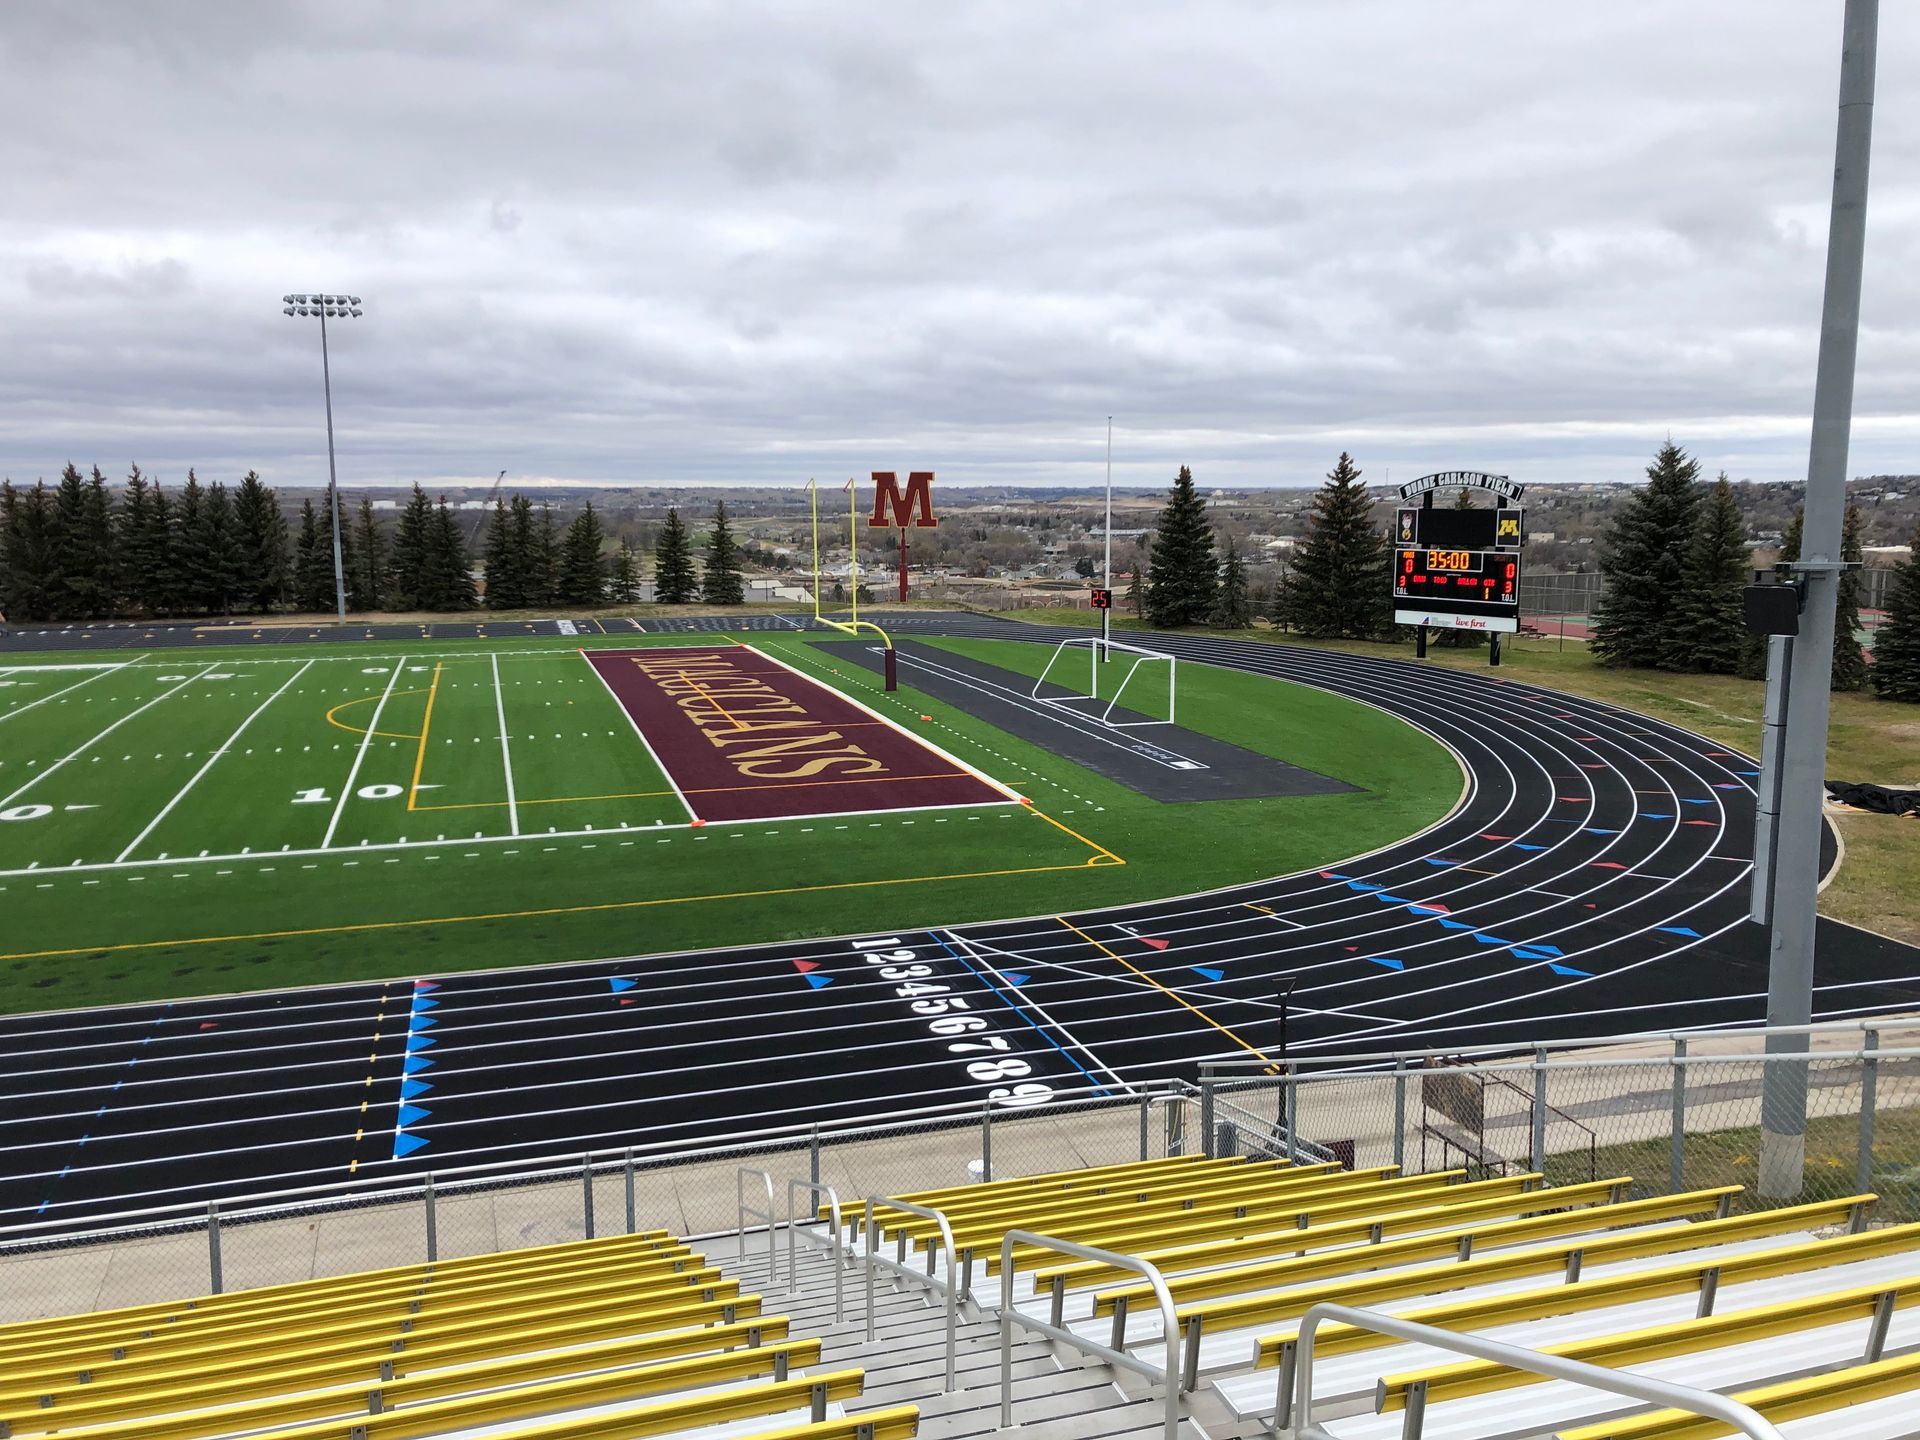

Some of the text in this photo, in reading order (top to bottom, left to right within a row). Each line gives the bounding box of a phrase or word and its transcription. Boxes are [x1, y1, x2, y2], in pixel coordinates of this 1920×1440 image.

[1404, 472, 1516, 497] DUANE CARLSON FIELD
[868, 471, 938, 528] M
[1498, 519, 1519, 536] M
[1405, 559, 1413, 573] 0
[1429, 551, 1469, 569] 35:00
[1506, 563, 1515, 578] 0
[1399, 576, 1406, 586] 3
[1505, 581, 1512, 593] 3
[1092, 591, 1107, 607] 25
[1485, 588, 1489, 600] 1
[1456, 616, 1469, 626] live
[1470, 619, 1487, 628] first
[631, 655, 890, 778] MAGICIANS
[851, 937, 902, 949] 1
[863, 949, 916, 964] 2
[879, 965, 932, 980] 3
[895, 982, 951, 997] 4
[910, 997, 971, 1014] 5
[928, 1016, 988, 1034] 6
[947, 1036, 1011, 1053] 7
[966, 1059, 1032, 1081] 8
[988, 1083, 1054, 1106] 9
